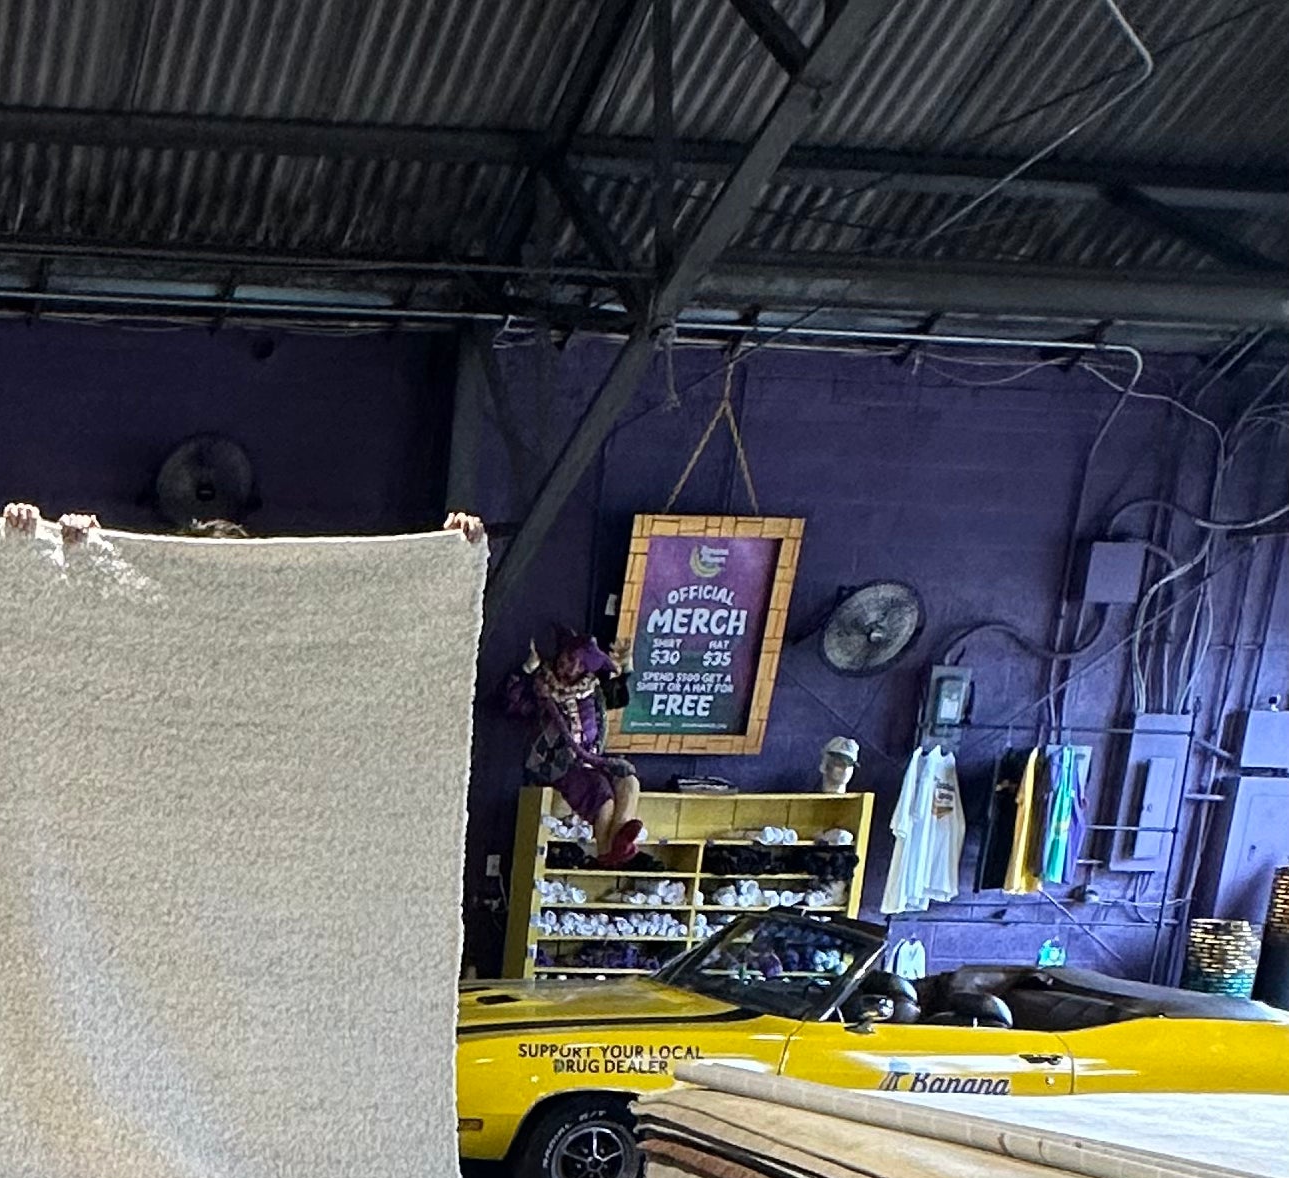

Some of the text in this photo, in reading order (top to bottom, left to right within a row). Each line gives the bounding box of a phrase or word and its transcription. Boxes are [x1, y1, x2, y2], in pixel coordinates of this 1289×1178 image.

[667, 585, 735, 606] OFFICIAL
[646, 607, 748, 636] MERCH
[652, 638, 730, 650] SHIRT HAT
[650, 648, 732, 667] $30 $35
[701, 673, 723, 683] GET
[666, 682, 682, 692] OR
[682, 682, 691, 693] A
[692, 683, 713, 693] HAT
[650, 694, 715, 716] FREE
[518, 1043, 705, 1060] SUPPORT YOUR LOCAL
[604, 1060, 669, 1074] DEALER
[909, 1072, 1010, 1096] Banana
